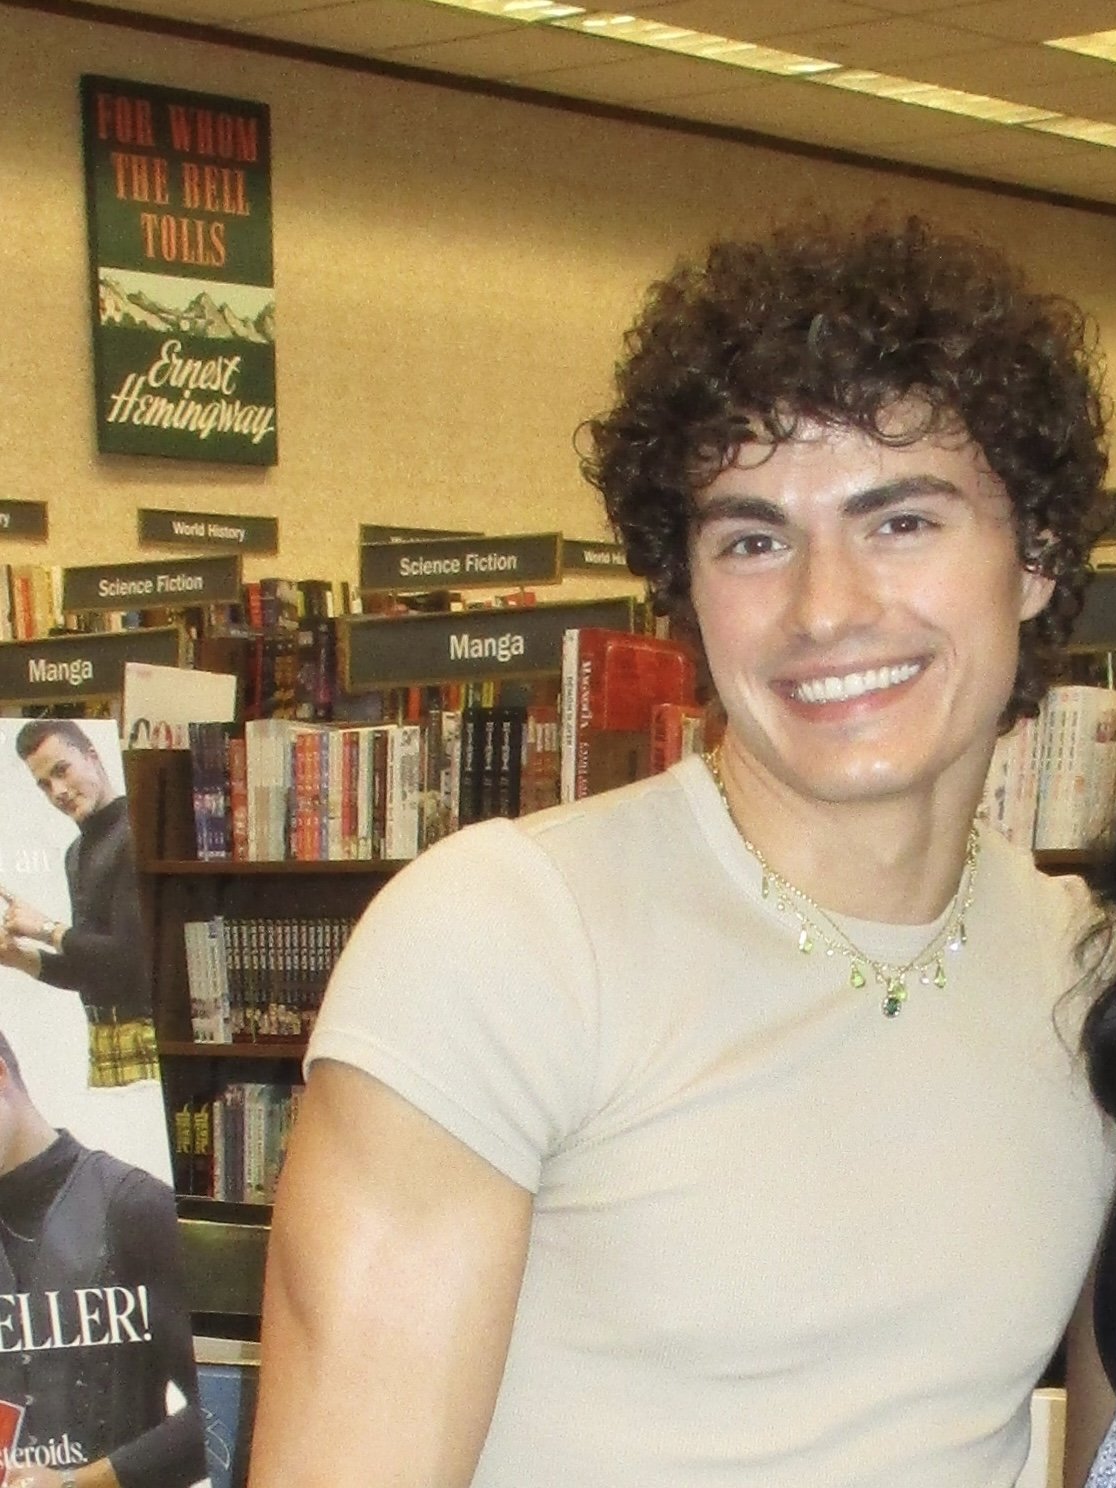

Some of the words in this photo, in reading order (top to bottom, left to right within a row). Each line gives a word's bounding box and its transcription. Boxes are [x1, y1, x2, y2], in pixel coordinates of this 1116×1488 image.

[97, 92, 155, 147] FOR
[168, 104, 258, 162] WHOM
[111, 151, 169, 205] THE
[183, 162, 250, 216] BELL
[140, 212, 226, 267] TOLLS
[148, 339, 241, 395] Ernest
[106, 372, 275, 444] Hemingway
[172, 521, 205, 537] World
[208, 523, 246, 543] History
[399, 557, 461, 577] Science
[465, 553, 518, 571] Fiction
[583, 550, 610, 564] World
[98, 578, 153, 598] Science
[156, 574, 204, 592] Fiction
[450, 632, 525, 662] Manga
[28, 659, 94, 686] Manga
[0, 1433, 88, 1471] teroids.
